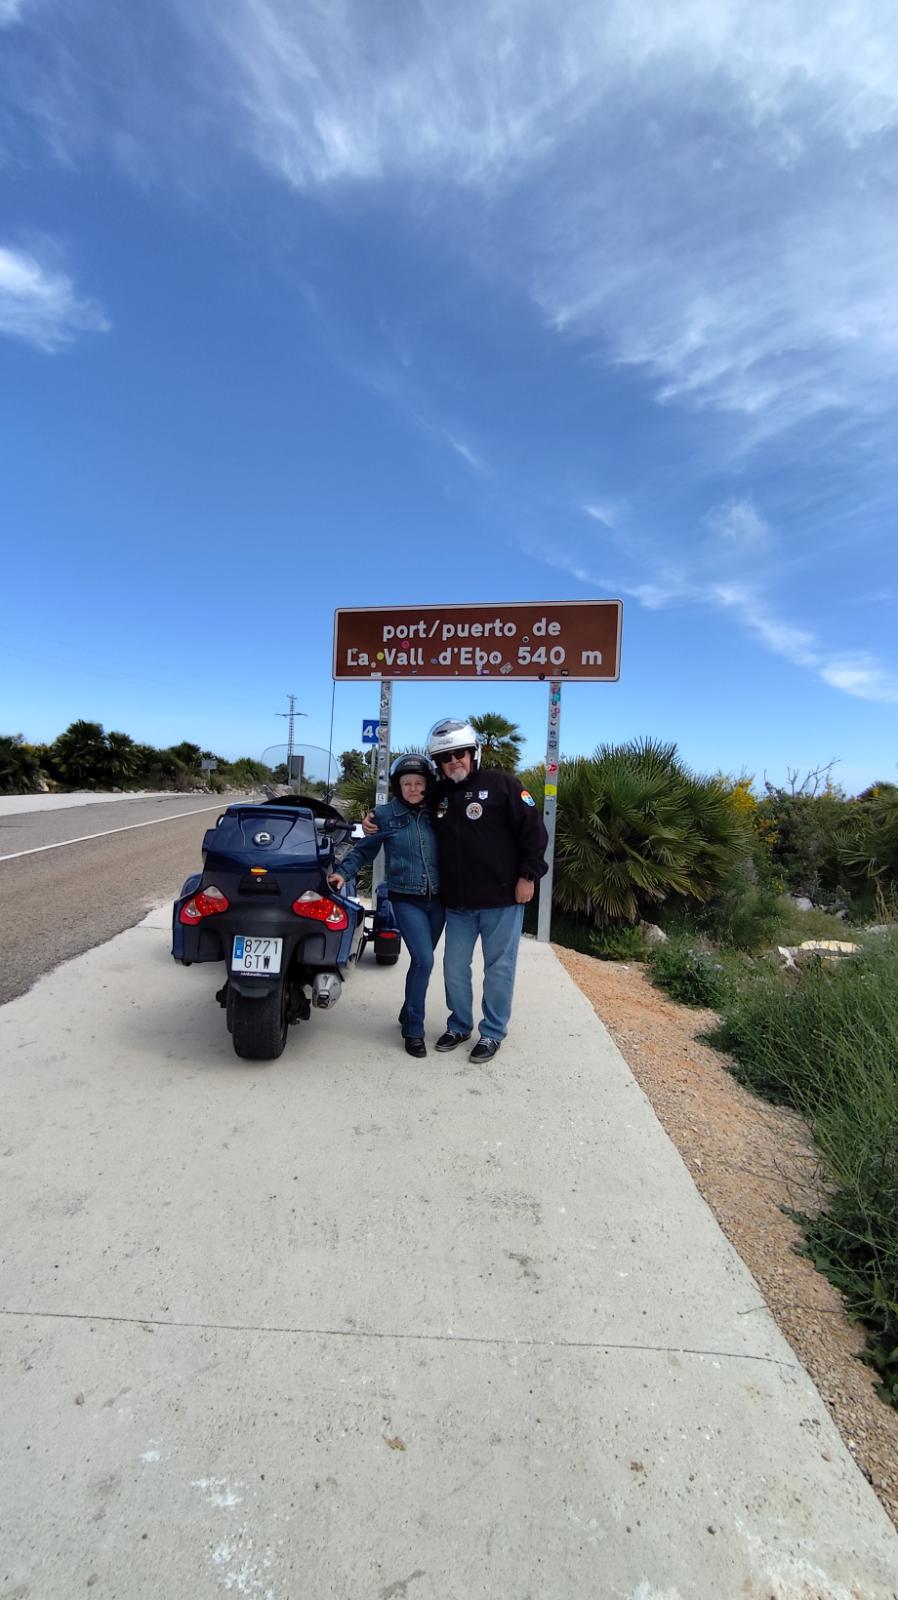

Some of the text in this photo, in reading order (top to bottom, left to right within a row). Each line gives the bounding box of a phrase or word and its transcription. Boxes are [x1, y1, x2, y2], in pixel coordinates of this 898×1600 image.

[382, 617, 561, 641] port/puerto de
[347, 645, 602, 666] La Vall d'Ebo 540 m
[244, 939, 278, 954] 8771
